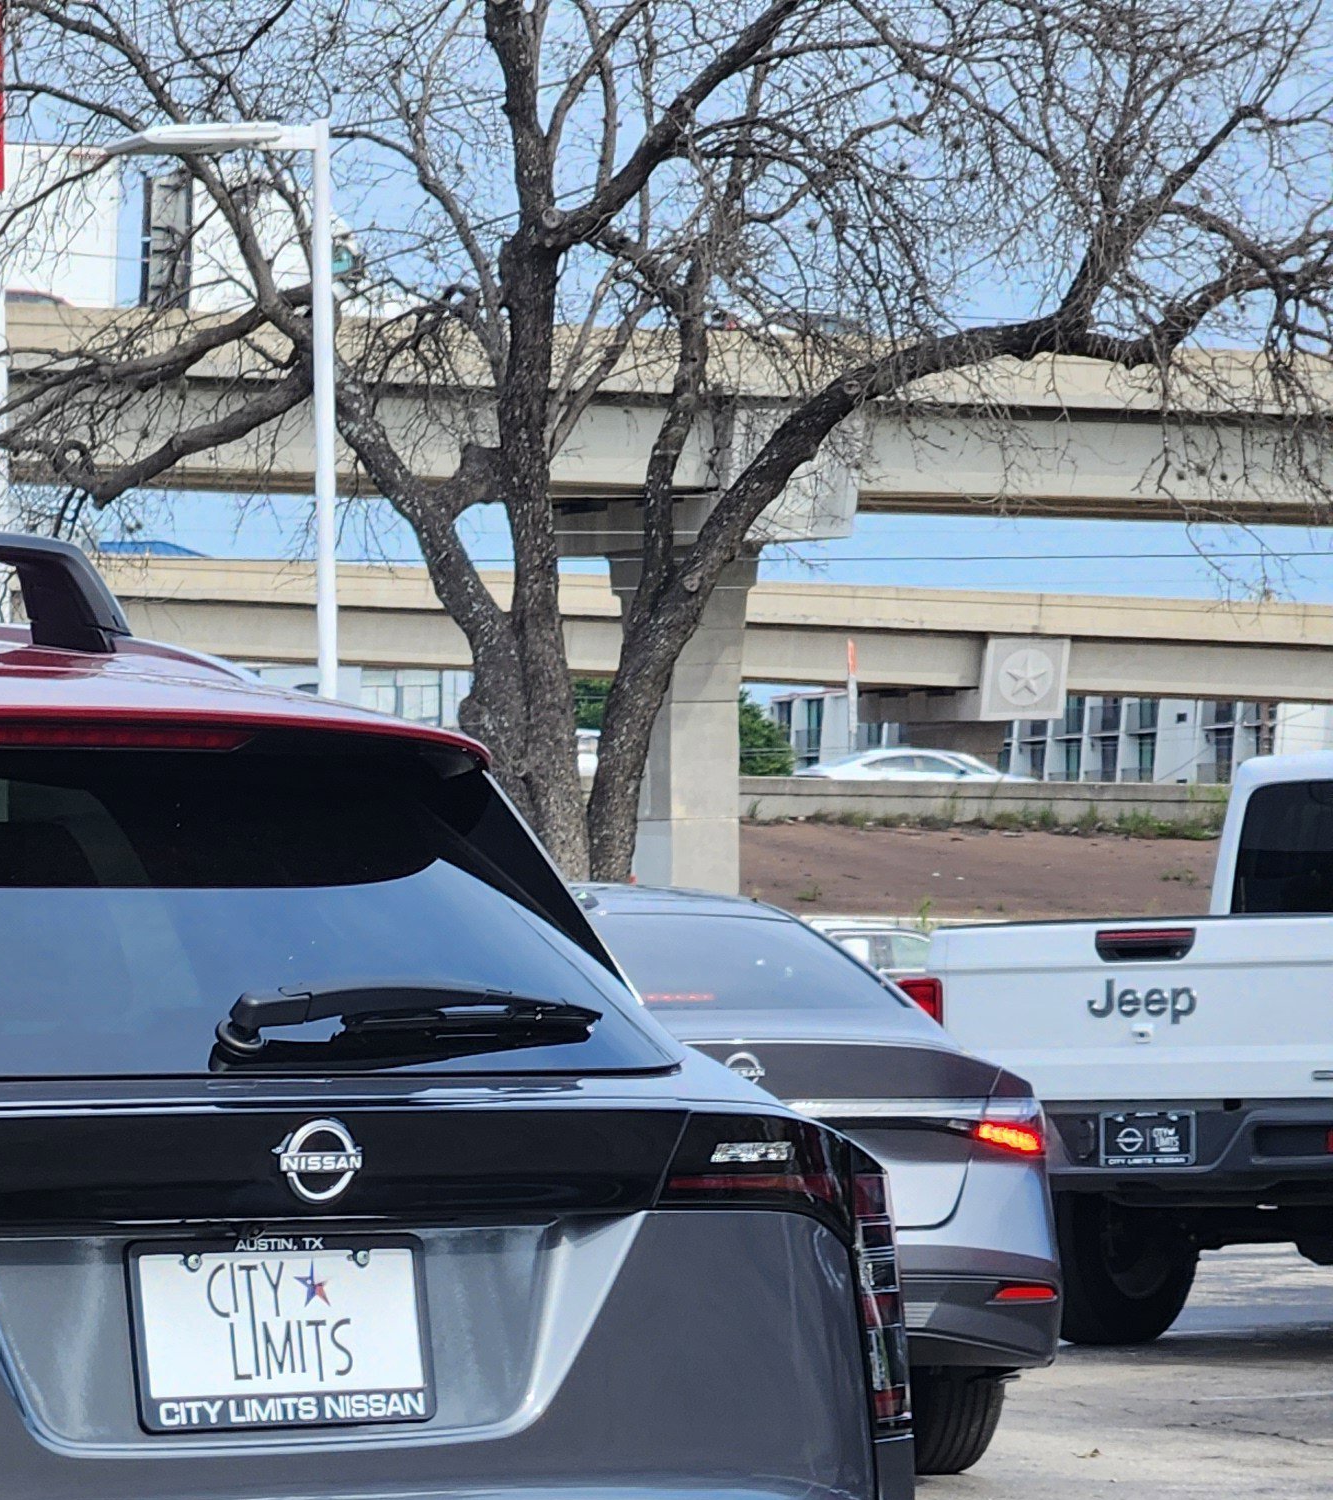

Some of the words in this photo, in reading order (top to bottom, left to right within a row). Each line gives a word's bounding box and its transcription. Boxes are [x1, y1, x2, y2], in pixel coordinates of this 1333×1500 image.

[1087, 978, 1198, 1025] Jeep
[282, 1154, 362, 1171] NISSAN
[234, 1237, 298, 1252] AUSTIN,
[301, 1237, 324, 1250] TX
[207, 1261, 284, 1318] CITY
[229, 1318, 353, 1382] LIMITS
[159, 1400, 227, 1427] CITY
[228, 1396, 319, 1423] LIMITS
[323, 1392, 426, 1419] NISSAN
